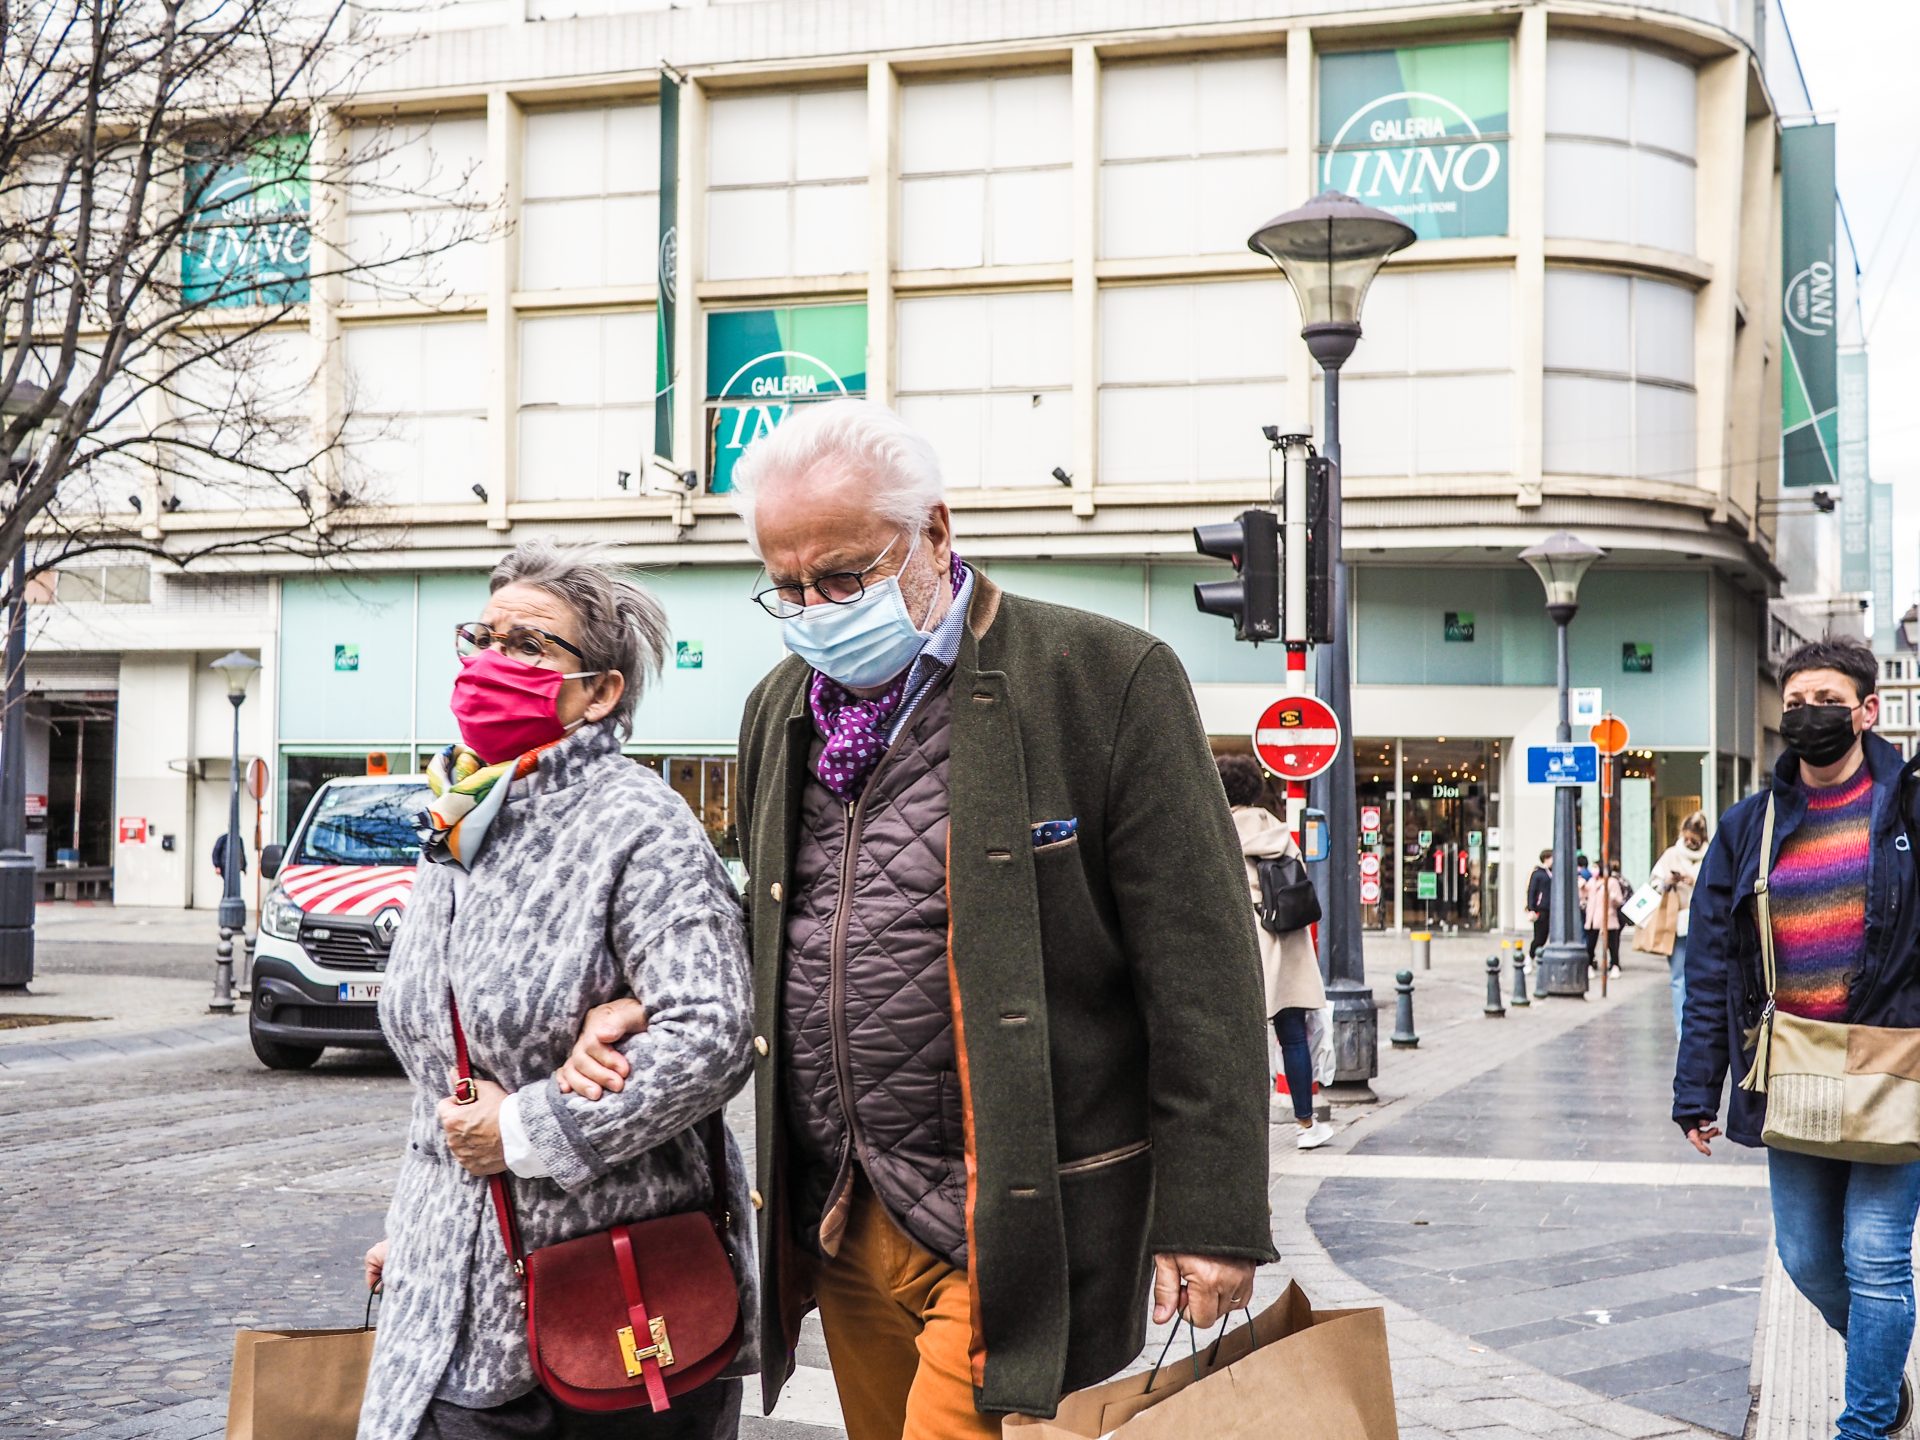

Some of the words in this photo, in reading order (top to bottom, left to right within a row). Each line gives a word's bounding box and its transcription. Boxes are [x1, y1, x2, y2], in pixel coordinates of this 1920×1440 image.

[1369, 117, 1447, 142] GALERIA
[1345, 143, 1501, 197] INNO
[199, 224, 312, 267] INNO
[1810, 260, 1834, 326] INNO
[751, 375, 819, 396] GALERIA
